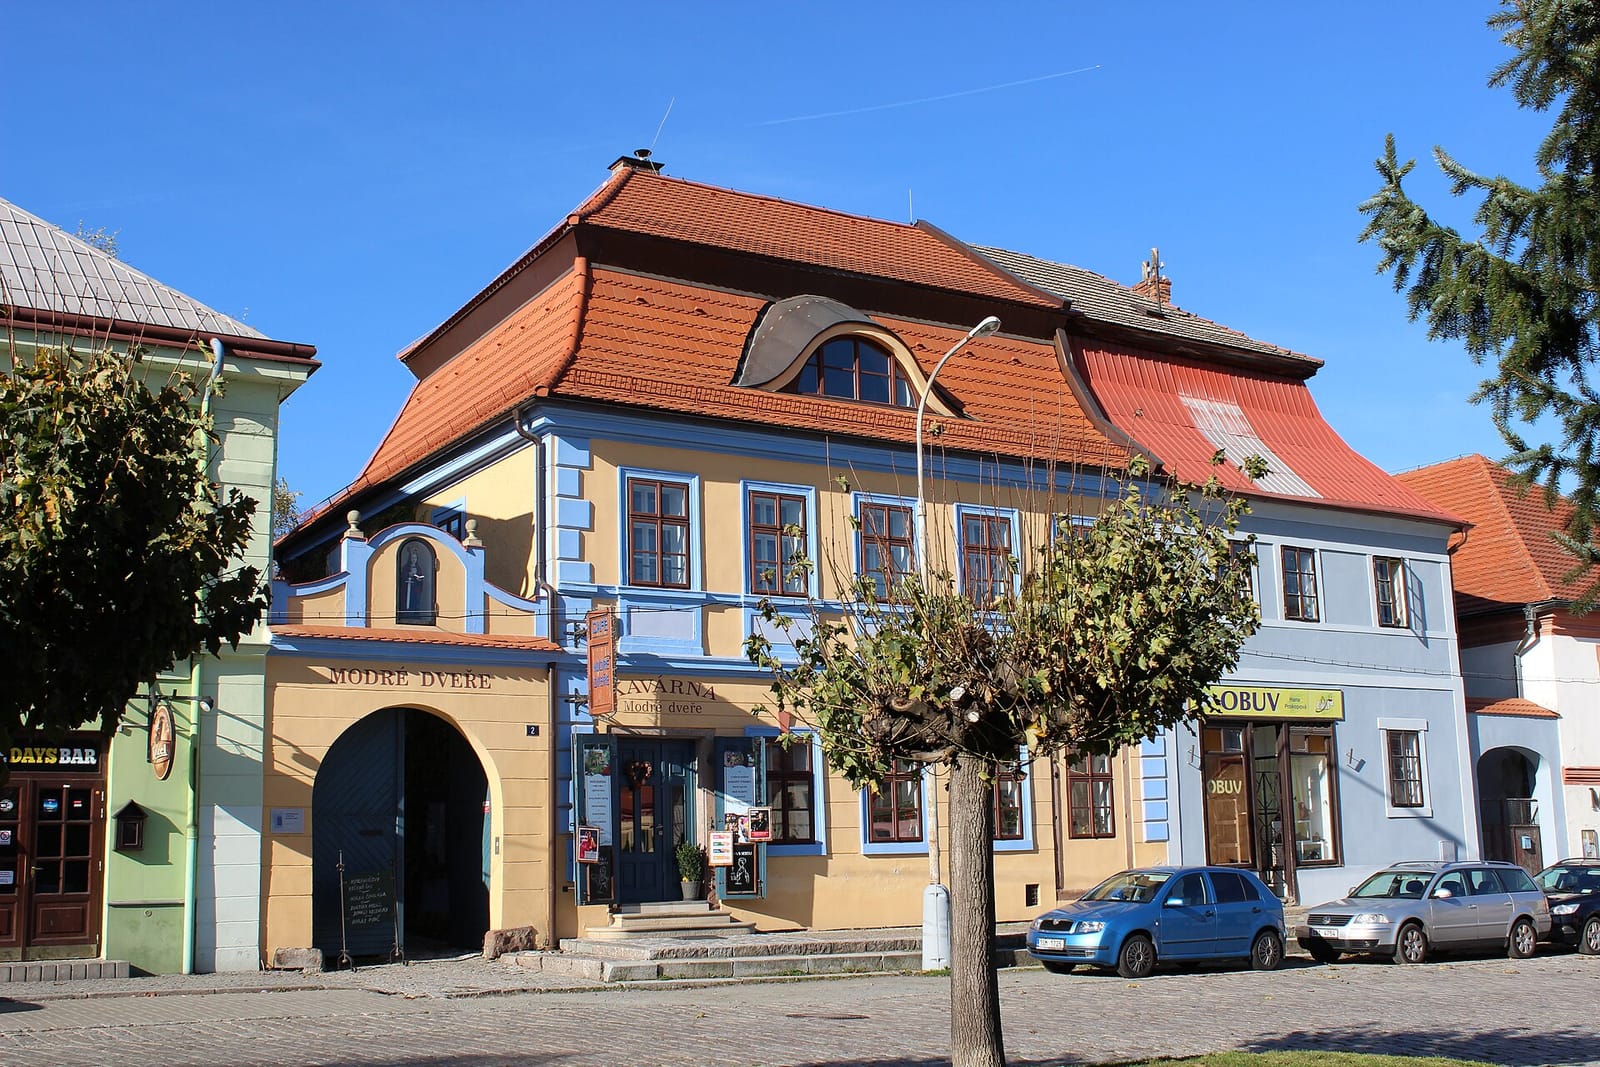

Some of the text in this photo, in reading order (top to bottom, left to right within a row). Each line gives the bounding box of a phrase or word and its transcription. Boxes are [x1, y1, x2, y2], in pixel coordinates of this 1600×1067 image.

[329, 666, 491, 689] MODRÉ DVEŘE
[624, 700, 702, 714] Modré dveře
[1220, 690, 1280, 712] OBUV
[9, 747, 58, 764] DAYS
[59, 748, 97, 765] BAR
[1207, 779, 1242, 794] OBUV
